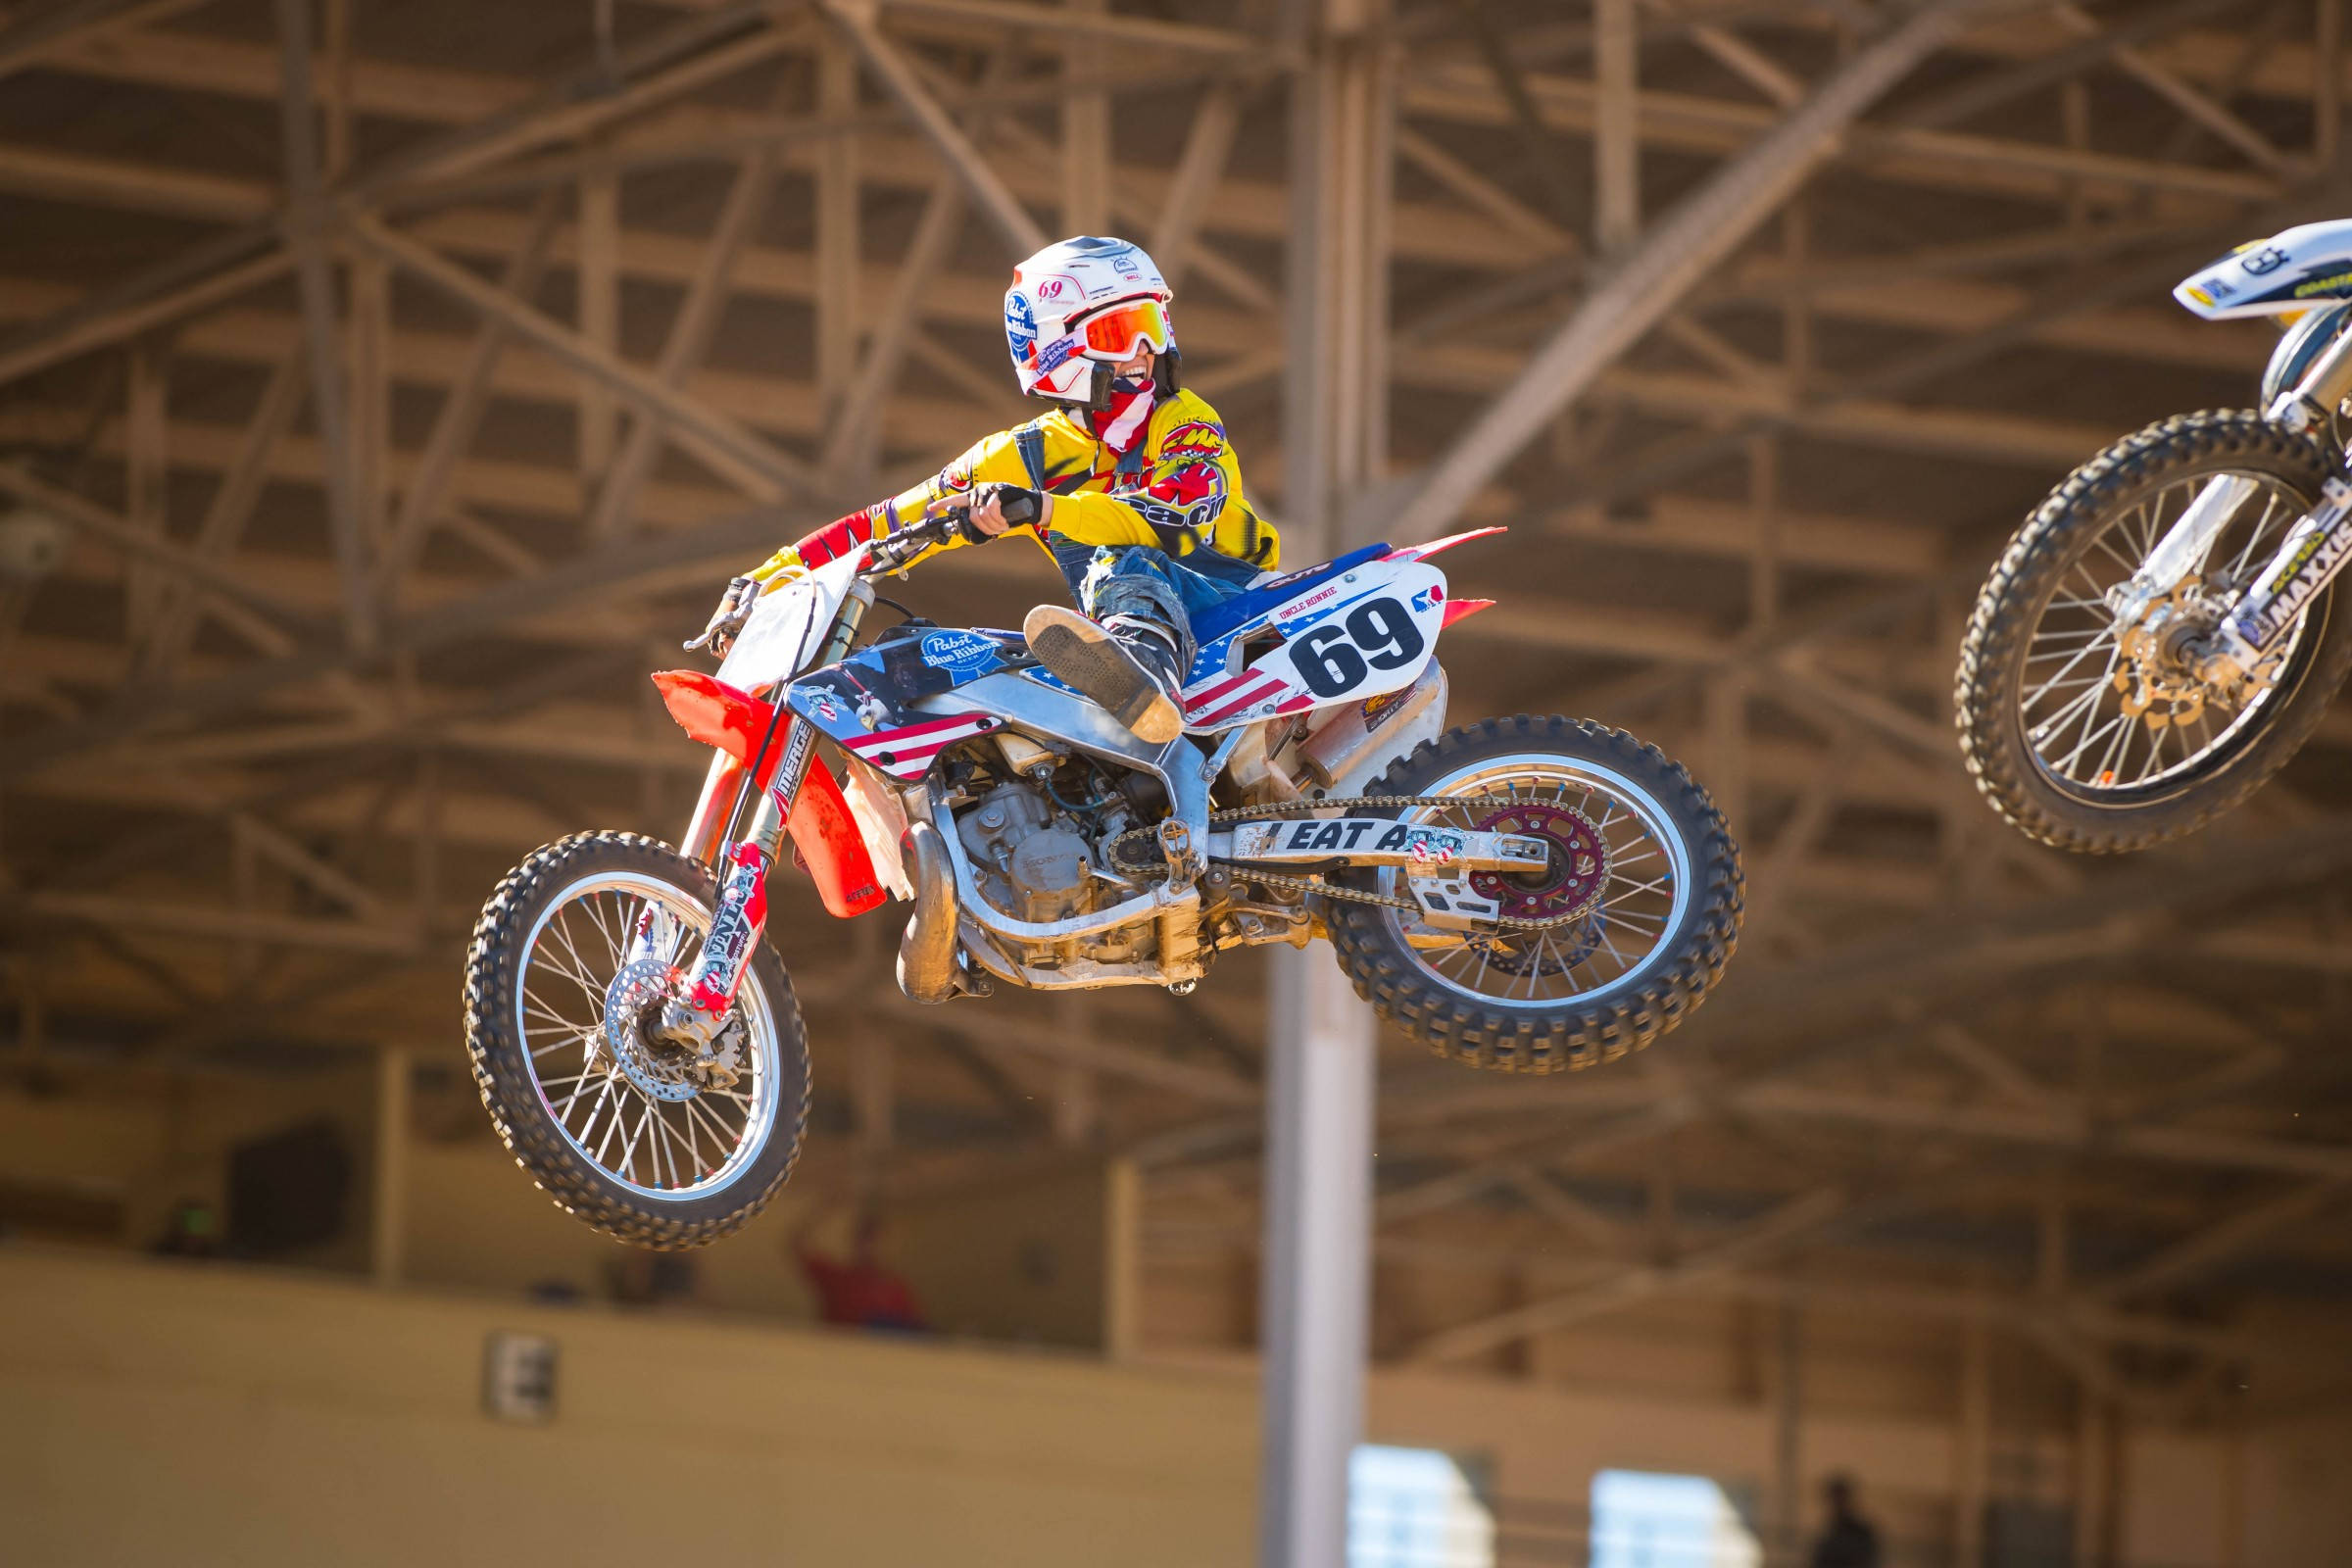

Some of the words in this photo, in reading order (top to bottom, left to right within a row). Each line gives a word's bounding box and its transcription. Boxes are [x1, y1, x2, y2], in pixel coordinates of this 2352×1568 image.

[1038, 280, 1063, 299] 69
[1048, 342, 1074, 363] Ribbon
[2269, 520, 2352, 626] MAXXIS
[1279, 600, 1306, 619] UNCLE
[1306, 586, 1338, 610] RONNIE
[925, 650, 955, 667] Blue
[955, 640, 1002, 661] Ribbon
[932, 633, 973, 652] Pabst
[1289, 597, 1425, 699] 69
[779, 720, 813, 797] MERGE
[1286, 822, 1374, 850] EAT
